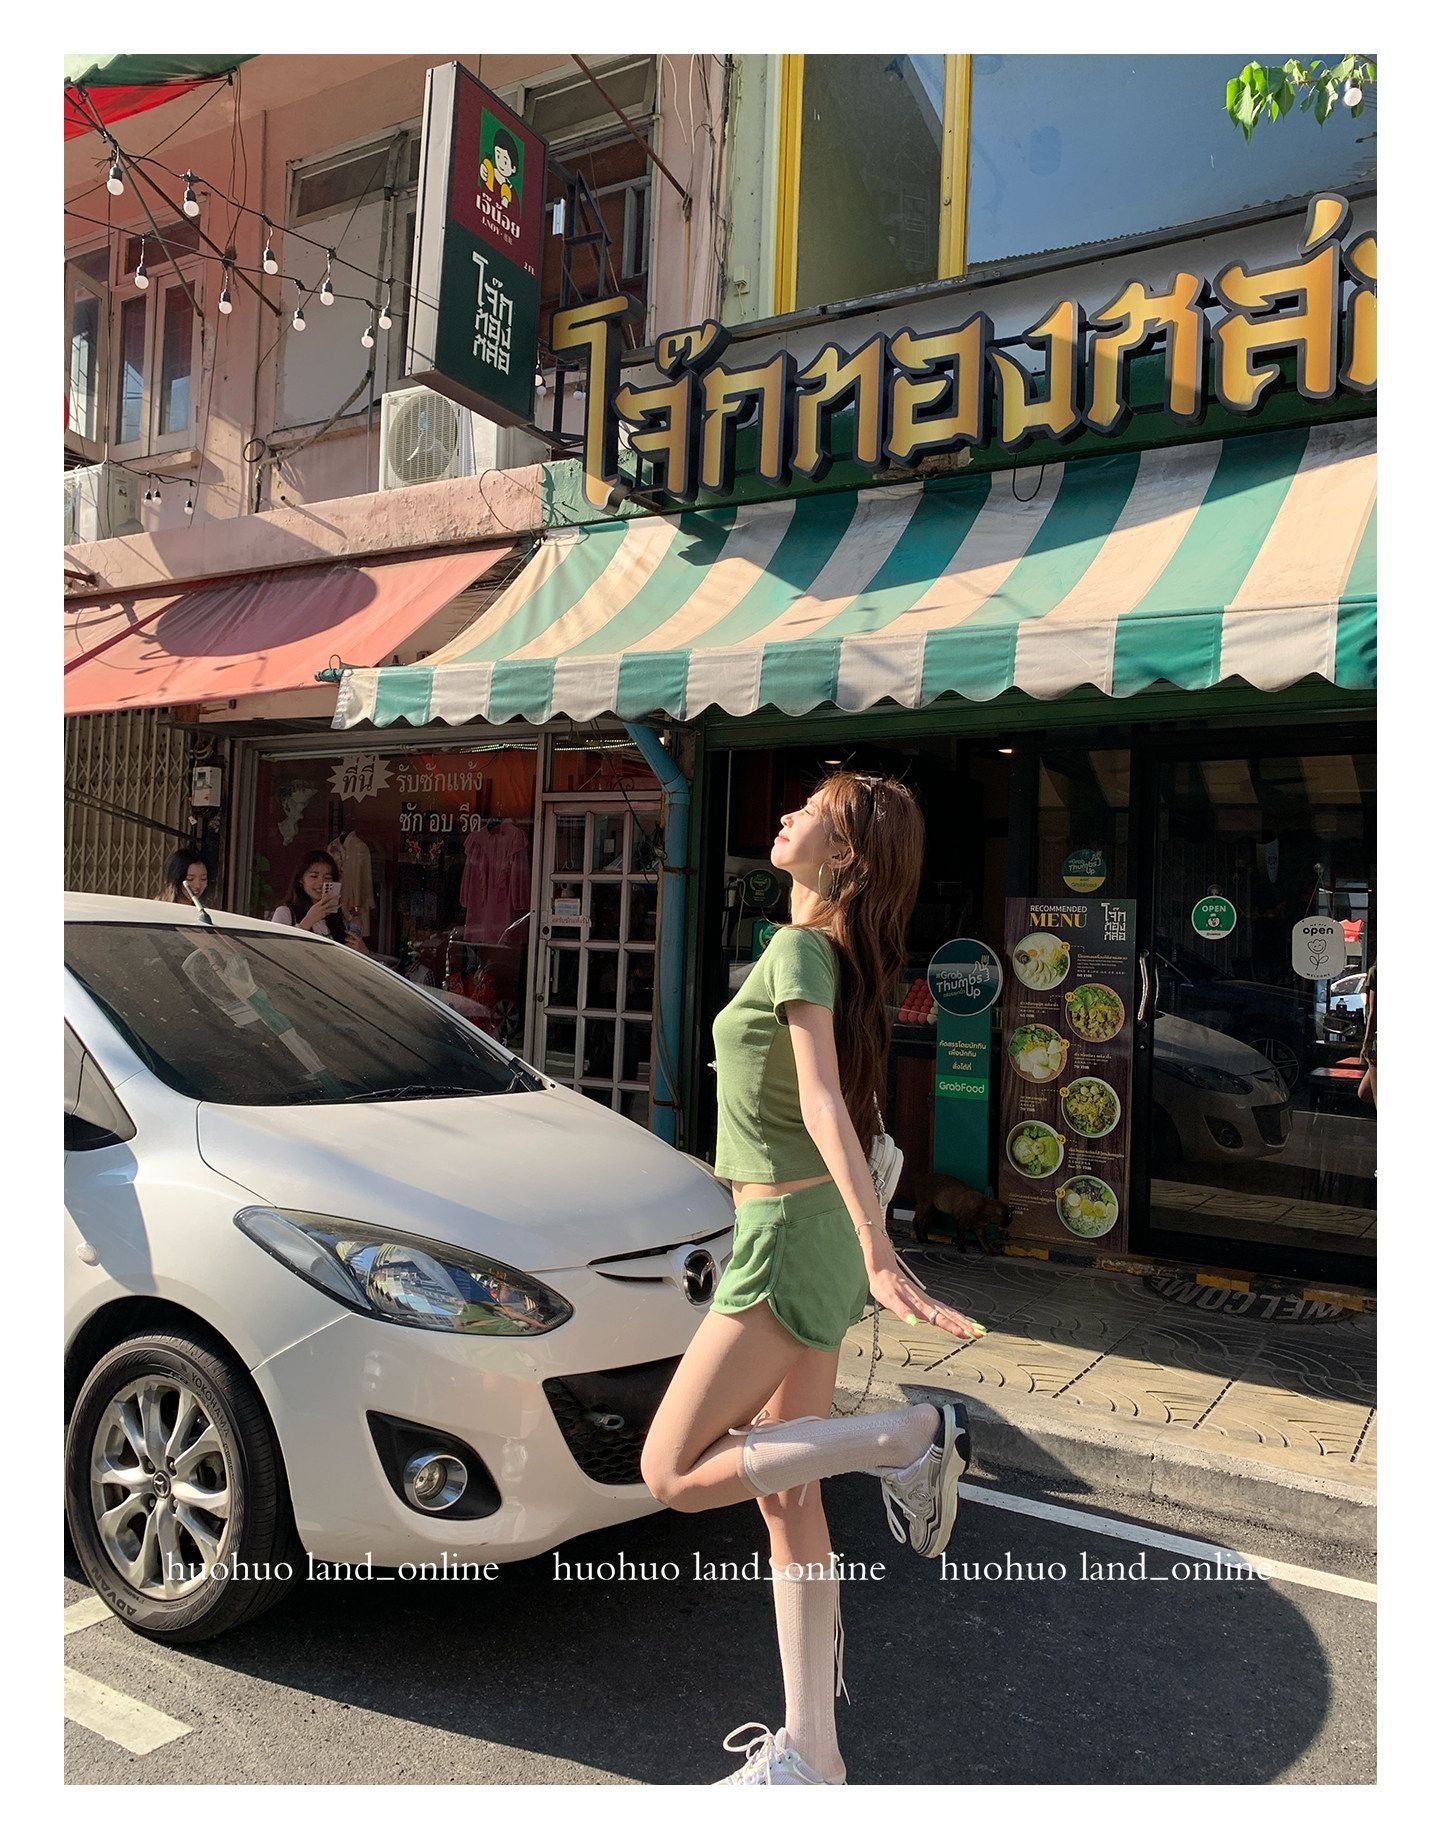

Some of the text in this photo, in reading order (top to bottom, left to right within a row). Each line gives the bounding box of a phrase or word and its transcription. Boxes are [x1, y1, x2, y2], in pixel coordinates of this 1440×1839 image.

[342, 755, 375, 793] ที่นี่
[396, 760, 484, 793] รับซักแห้ง
[399, 802, 482, 833] ซัก อบ รีด
[1029, 904, 1088, 913] RECOMMENDED
[1201, 905, 1227, 913] OPEN
[1029, 912, 1088, 928] MENU
[1303, 927, 1334, 936] open
[935, 973, 983, 993] Thumbs
[965, 985, 981, 999] Up
[938, 1081, 985, 1094] GrabFood
[1150, 1277, 1346, 1320] WELCOME
[191, 1371, 230, 1438] YOKOHAMA
[91, 1565, 138, 1616] ADVAN
